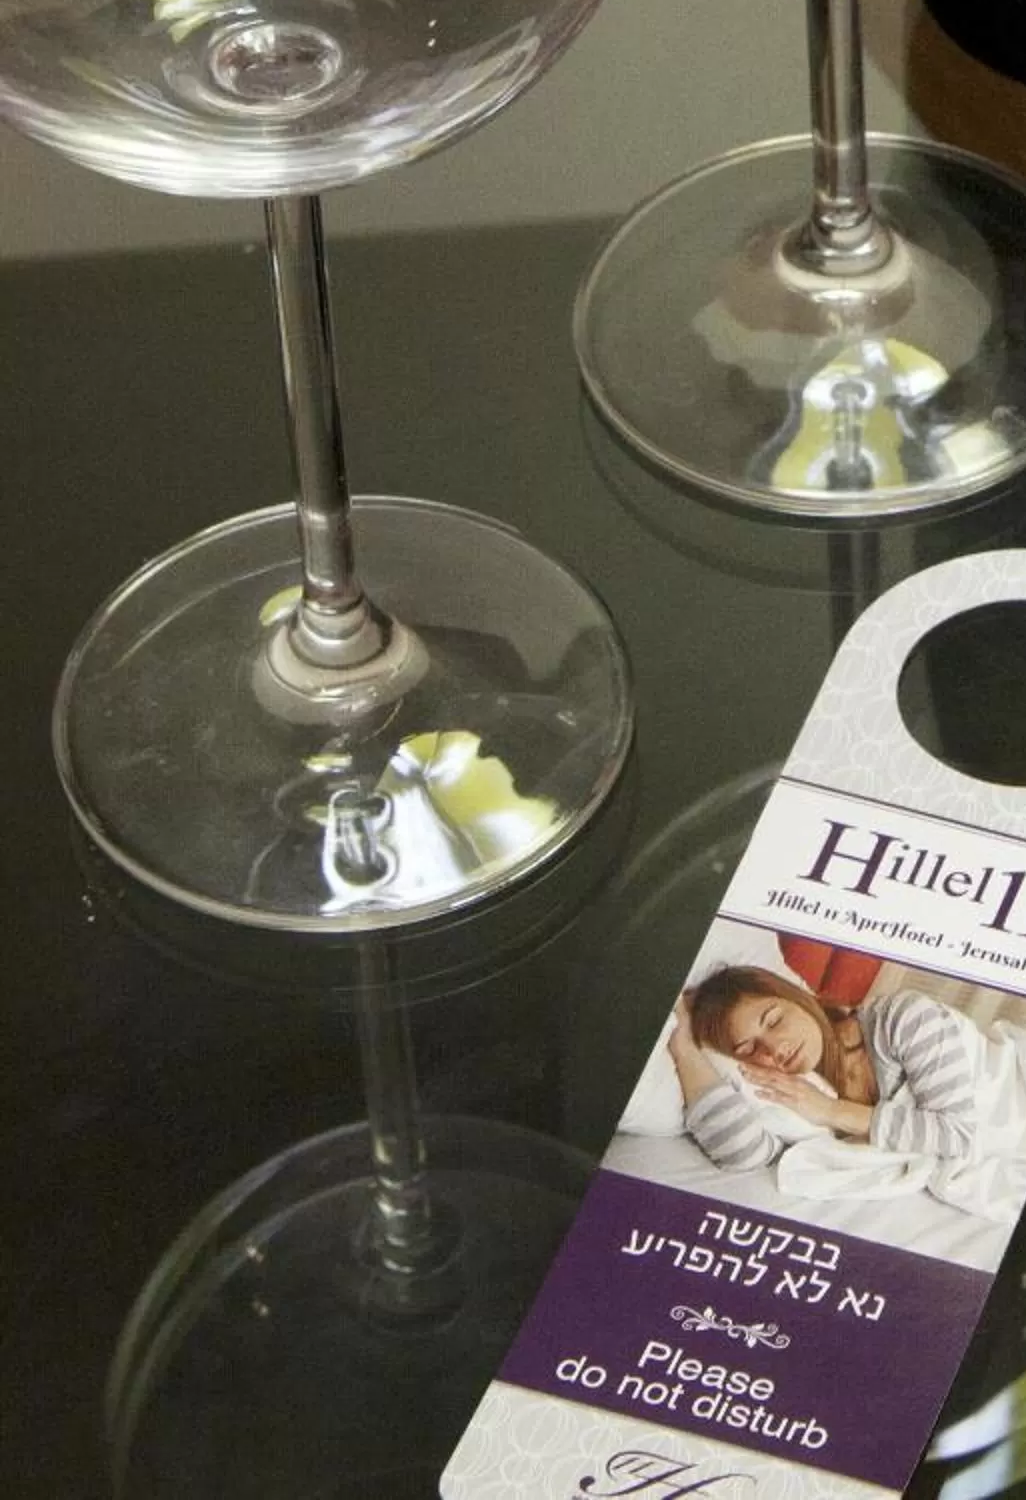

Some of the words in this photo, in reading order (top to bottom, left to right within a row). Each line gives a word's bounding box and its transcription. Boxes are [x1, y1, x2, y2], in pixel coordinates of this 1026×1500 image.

[767, 888, 821, 916] Hillel
[621, 1228, 769, 1288] להפריע
[698, 1210, 842, 1271] בבקשה
[773, 1269, 830, 1304] לא
[837, 1285, 886, 1322] נא
[637, 1340, 775, 1402] Please
[555, 1354, 607, 1389] do
[616, 1370, 684, 1413] not
[691, 1391, 830, 1451] disturb
